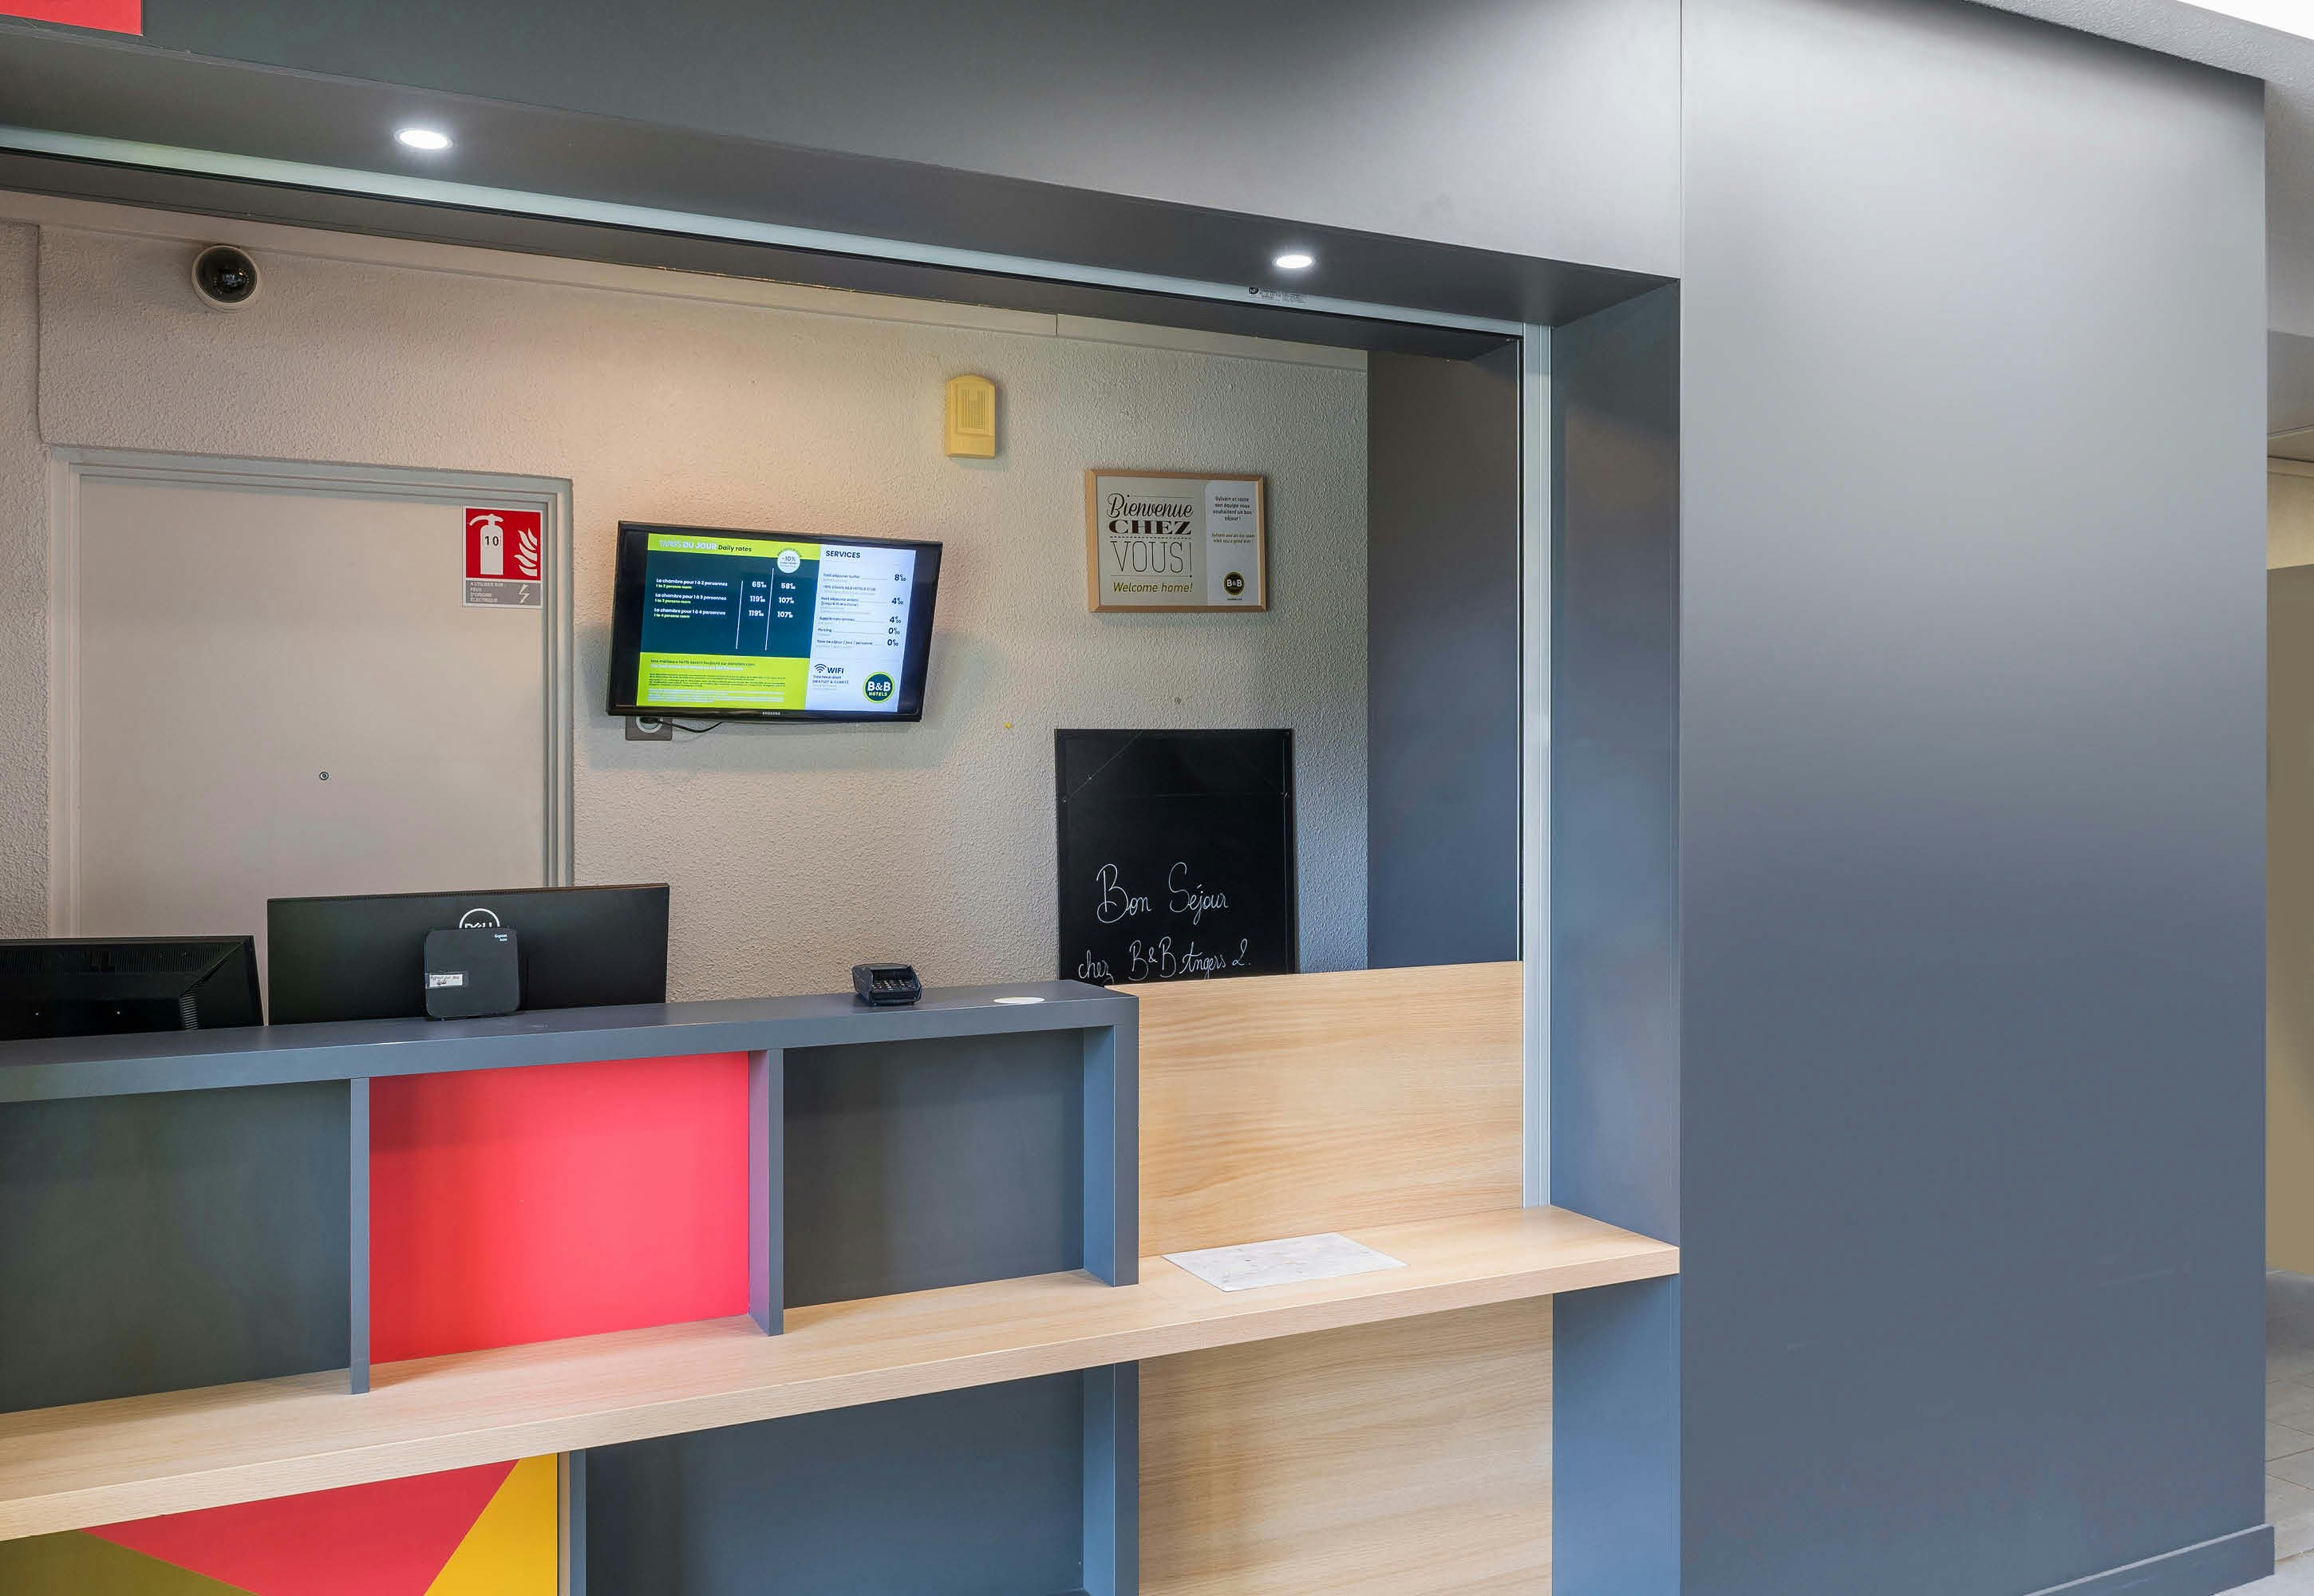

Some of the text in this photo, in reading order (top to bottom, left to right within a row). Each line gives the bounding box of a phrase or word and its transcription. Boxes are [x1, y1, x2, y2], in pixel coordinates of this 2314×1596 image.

[1106, 493, 1194, 519] Bienvenue
[1109, 519, 1192, 535] CHEZ
[485, 536, 499, 546] 10
[659, 540, 682, 549] TARIFS
[1113, 582, 1193, 593] Welcome home!
[1227, 579, 1242, 587] B&B
[867, 681, 891, 691] B&B
[1096, 862, 1229, 925] Bon Séjour
[1078, 950, 1114, 985] chez
[1128, 936, 1177, 981] B&B
[1179, 941, 1226, 980] Angers
